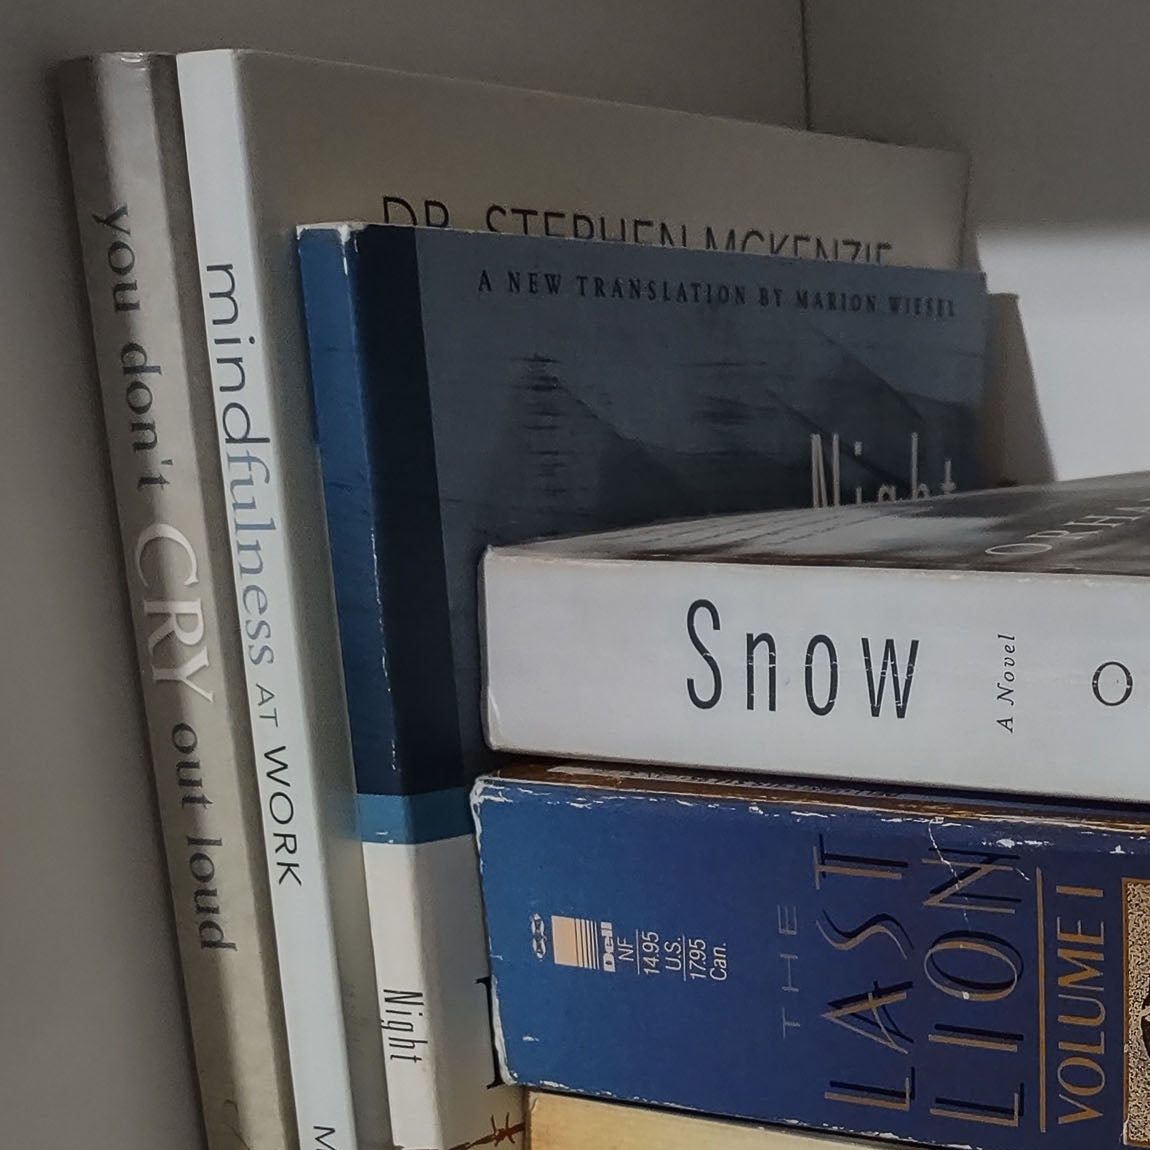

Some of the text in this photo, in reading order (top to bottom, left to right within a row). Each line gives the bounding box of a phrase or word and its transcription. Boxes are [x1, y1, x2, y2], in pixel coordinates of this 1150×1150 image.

[478, 269, 492, 293] A
[508, 271, 562, 296] NEW
[576, 275, 746, 306] TRANSLATION
[758, 287, 784, 308] BY
[796, 291, 877, 315] MARION
[93, 204, 238, 952] you don't CRY out loud
[206, 262, 302, 886] mindfulness AT WORK
[686, 599, 919, 719] Snow
[997, 633, 1016, 706] Novel
[617, 937, 634, 962] NF
[642, 931, 660, 975] 14.95
[664, 938, 682, 971] U.S.
[688, 939, 707, 980] 17.95
[709, 943, 728, 981] Can.
[777, 904, 801, 1039] THE
[813, 843, 912, 1111] LAST
[380, 987, 428, 1064] Night
[922, 857, 1022, 1128] LION
[1056, 917, 1106, 1125] VOLUME
